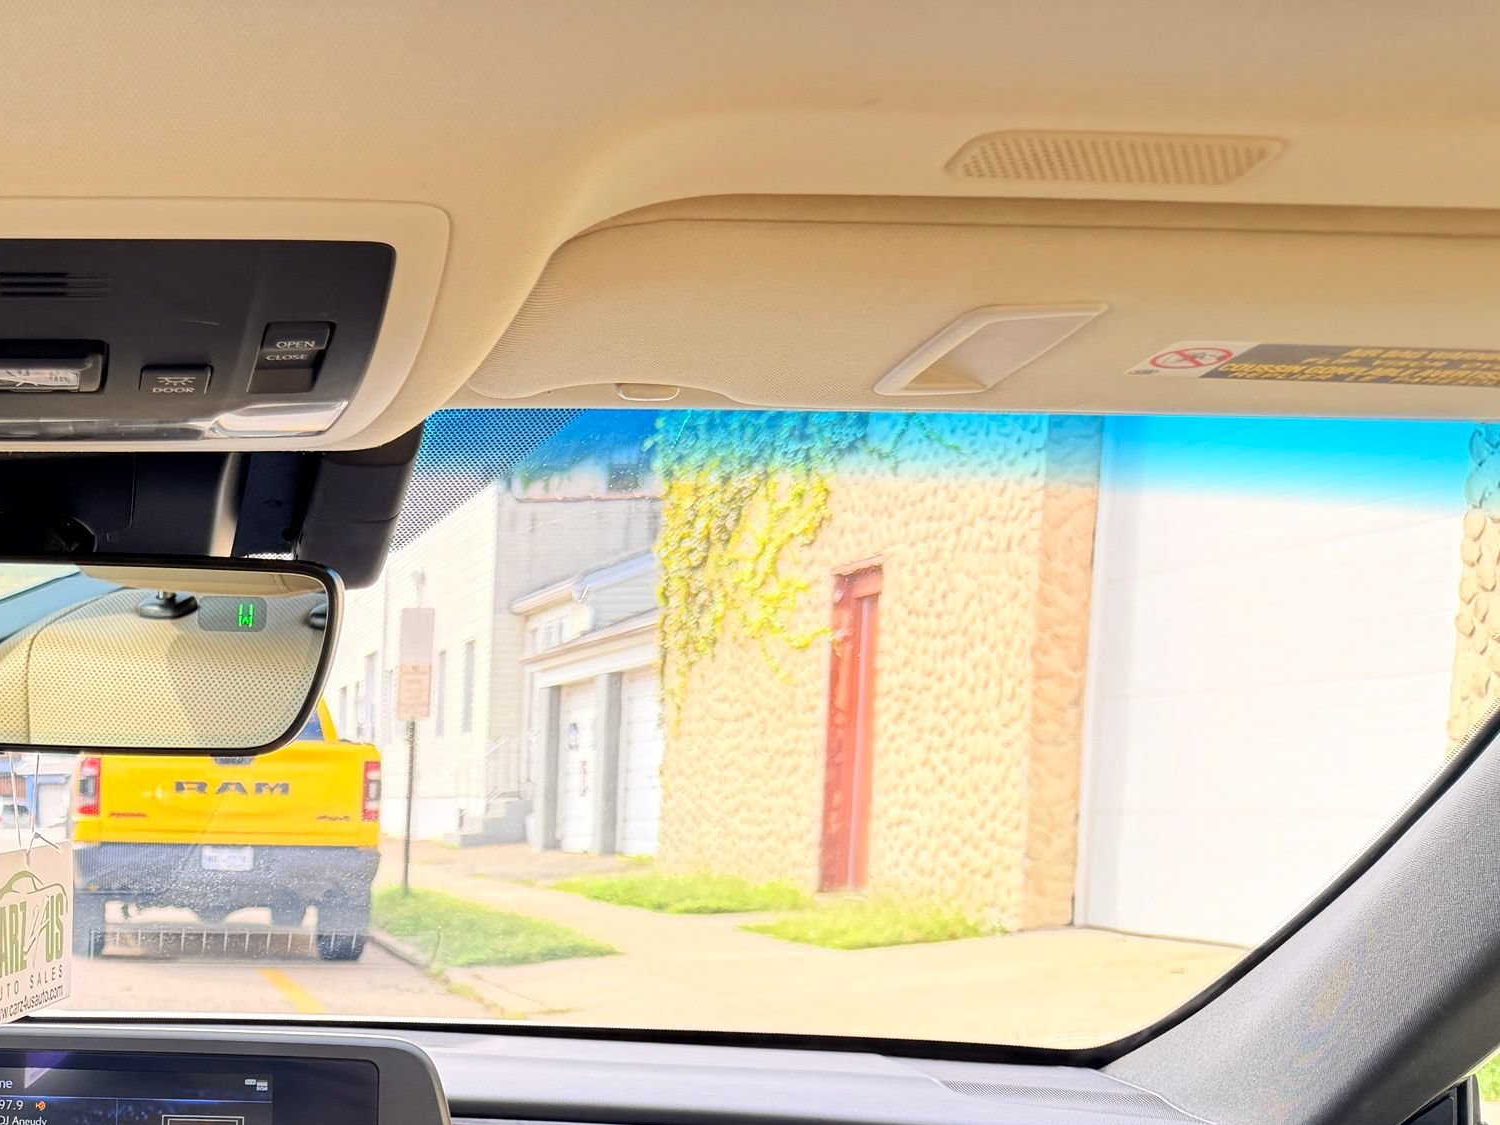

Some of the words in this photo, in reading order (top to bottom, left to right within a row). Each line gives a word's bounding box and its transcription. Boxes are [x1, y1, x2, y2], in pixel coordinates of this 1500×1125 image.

[276, 341, 315, 349] OPEN
[175, 781, 290, 795] RAM
[45, 892, 64, 963] US
[29, 964, 63, 990] SALES
